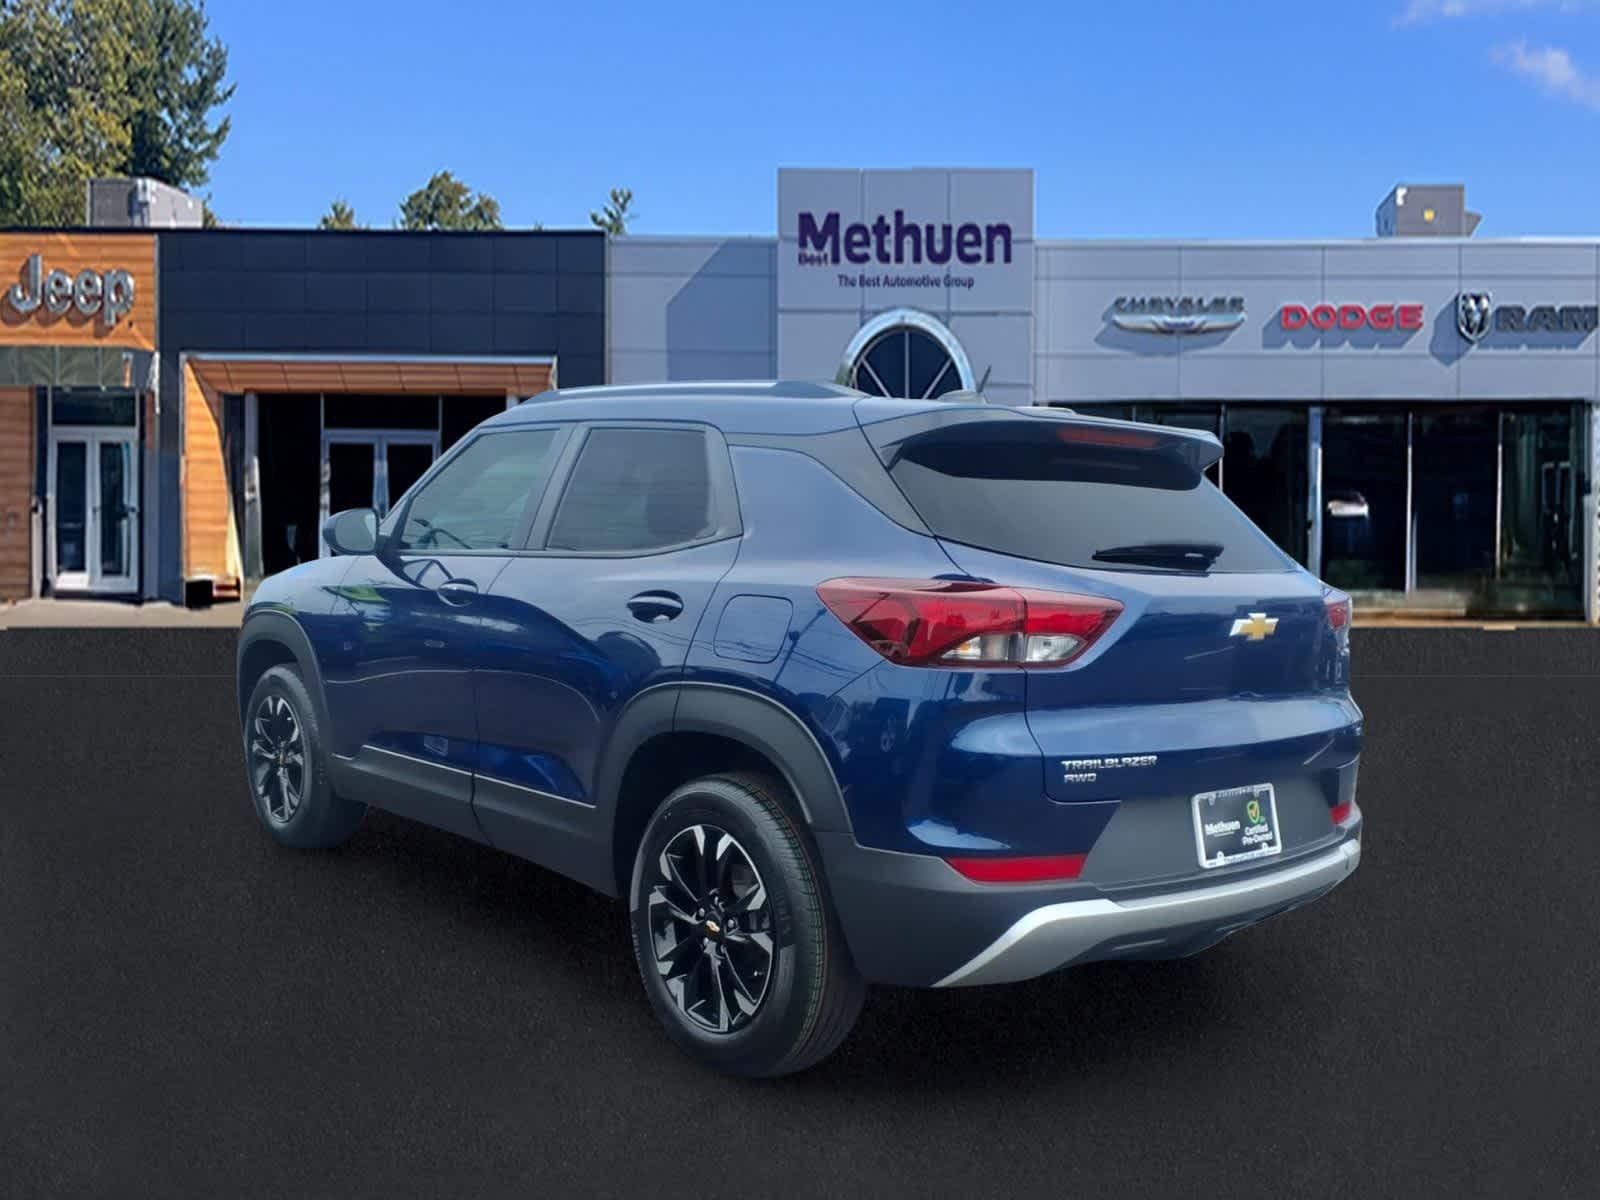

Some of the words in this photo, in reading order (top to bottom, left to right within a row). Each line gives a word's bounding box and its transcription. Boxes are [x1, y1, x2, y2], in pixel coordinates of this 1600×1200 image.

[798, 210, 1012, 264] Methuen
[9, 254, 135, 326] Jeep
[838, 274, 856, 287] The
[859, 274, 880, 287] Best
[883, 273, 940, 288] Automotive
[943, 274, 974, 290] Group
[1113, 296, 1245, 312] CHRYSLER
[1280, 304, 1424, 331] DODGE
[1495, 305, 1599, 333] RAM
[1061, 755, 1158, 771] TRAILBLAZER
